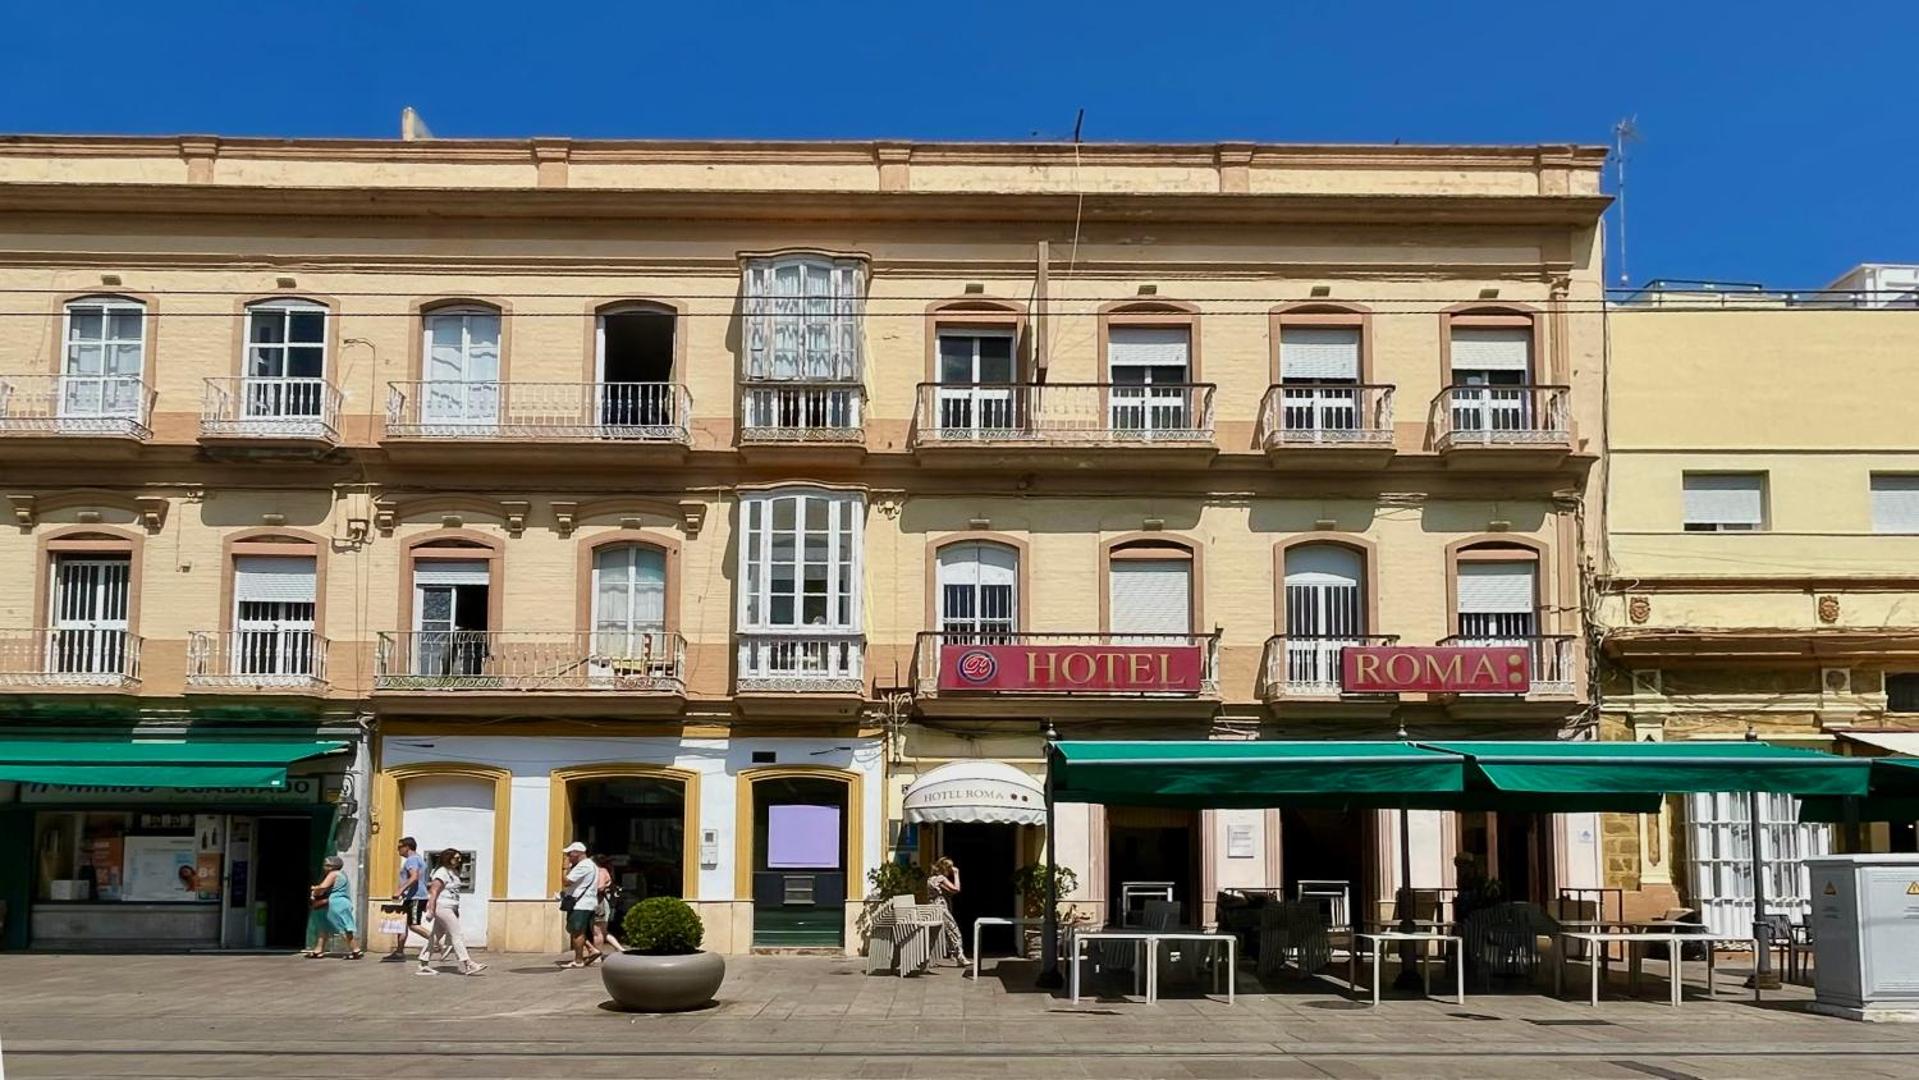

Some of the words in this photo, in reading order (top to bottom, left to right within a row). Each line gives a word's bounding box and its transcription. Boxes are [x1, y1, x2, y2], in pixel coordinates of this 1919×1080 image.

[1026, 652, 1185, 685] HOTEL
[1355, 653, 1502, 685] ROMA
[924, 790, 963, 802] HOTEL
[965, 789, 1004, 800] ROMA
